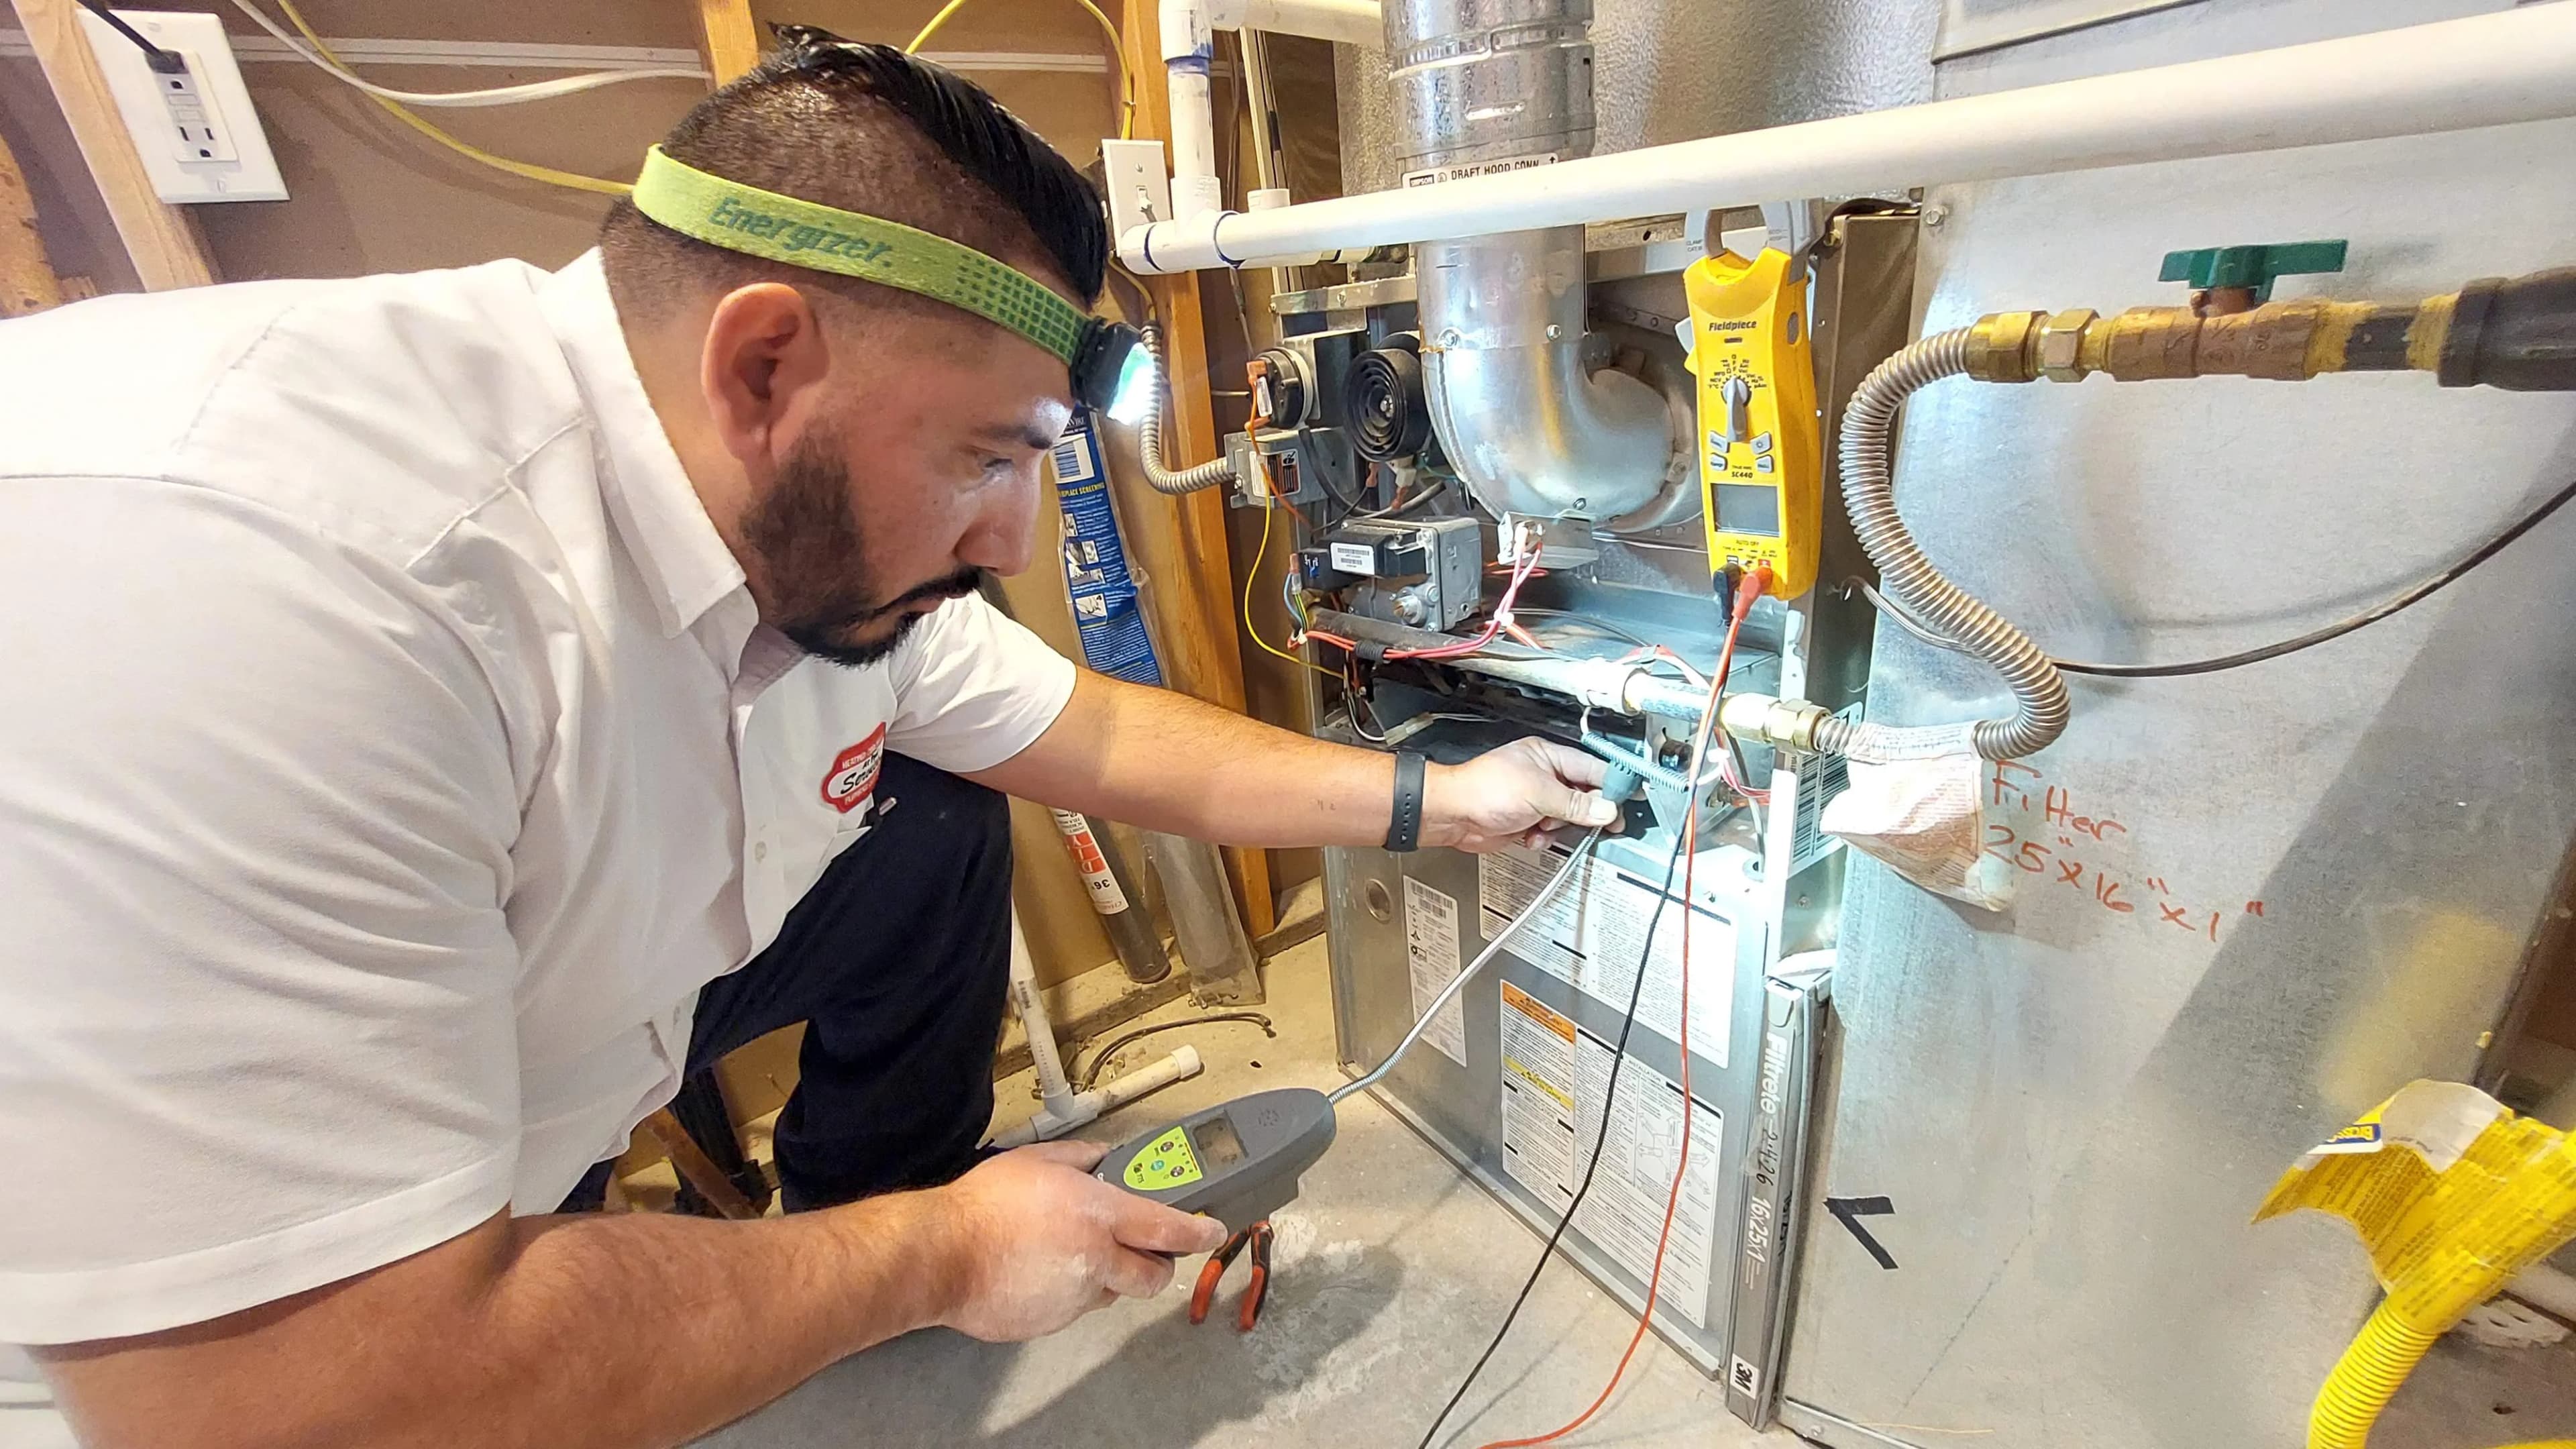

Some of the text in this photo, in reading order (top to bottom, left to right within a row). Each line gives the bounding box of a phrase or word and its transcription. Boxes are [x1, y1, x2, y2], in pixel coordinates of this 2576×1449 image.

[1452, 167, 1481, 180] DRAFT
[1485, 164, 1511, 175] HOOD
[1709, 321, 1757, 331] Fieldpiece
[1992, 760, 2126, 840] Filter
[1760, 1031, 1787, 1114] Filtrete
[1747, 1196, 1771, 1263] 16x25x1
[1735, 1363, 1753, 1391] 3M
